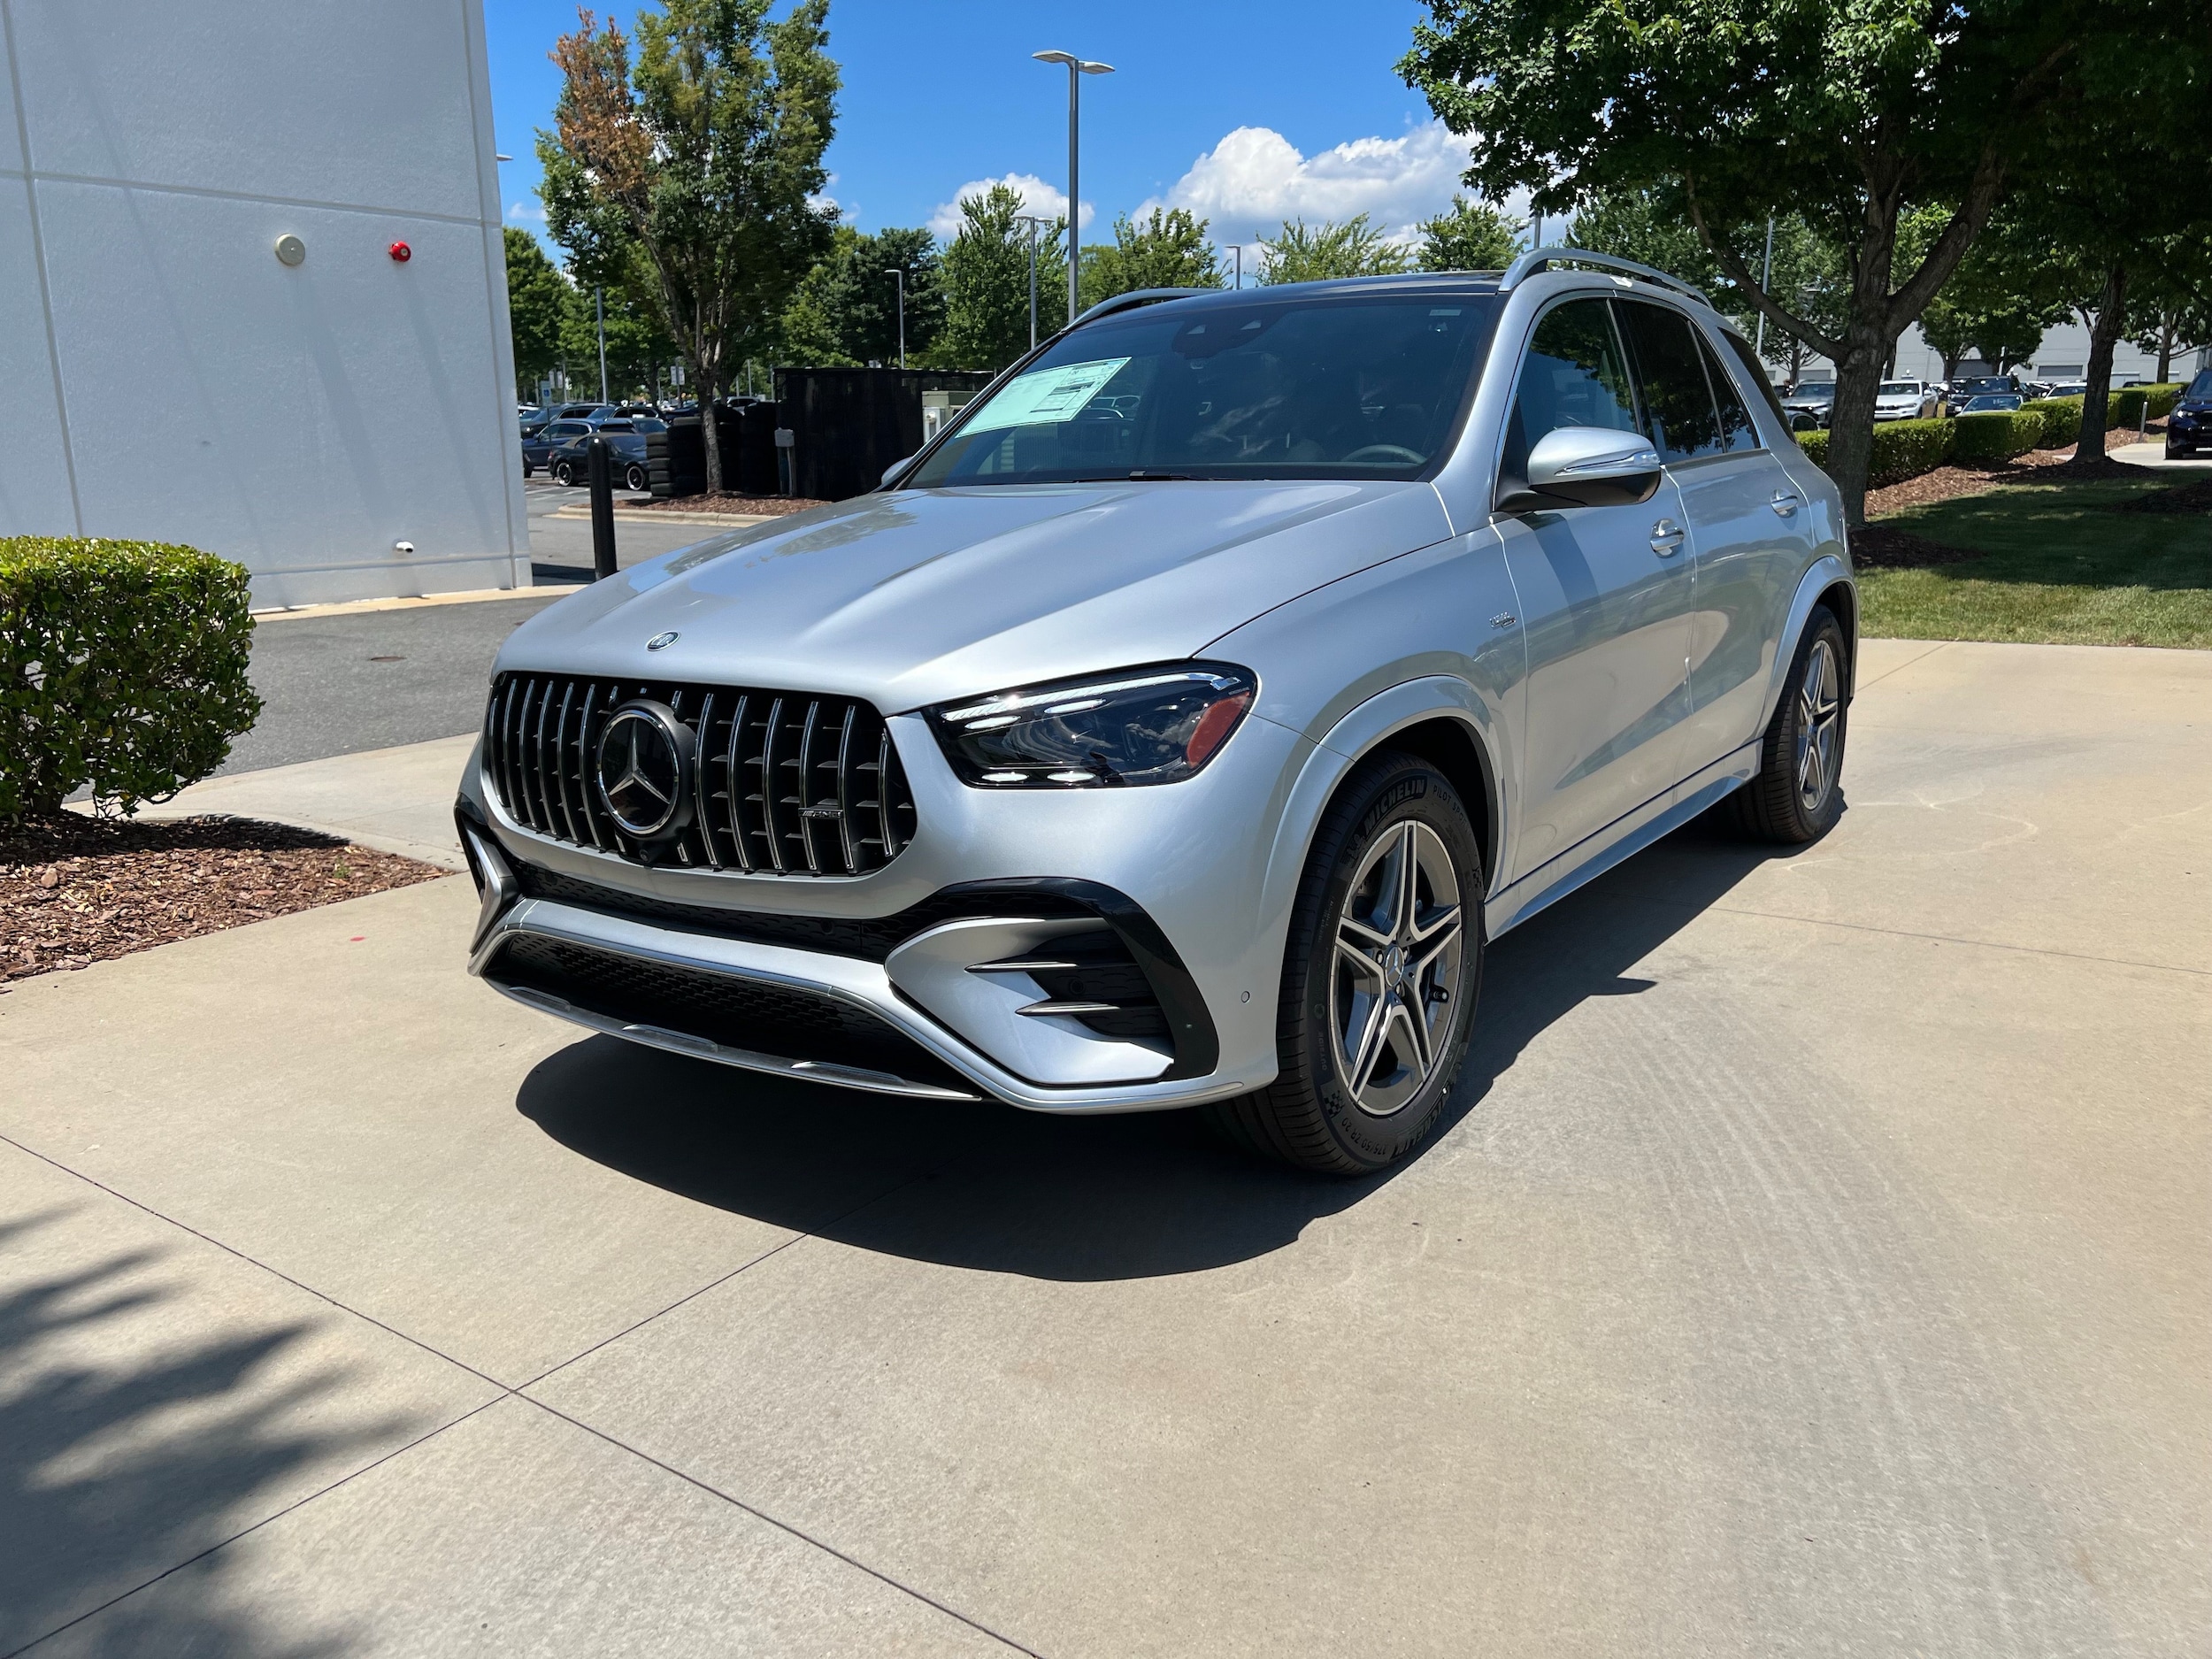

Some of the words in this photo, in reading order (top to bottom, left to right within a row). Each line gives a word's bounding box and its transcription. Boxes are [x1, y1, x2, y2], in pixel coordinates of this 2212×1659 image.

[1363, 779, 1425, 835] MICHELIN
[1432, 785, 1452, 804] PILOT
[1317, 1032, 1328, 1071] OUTSIDE
[1341, 1118, 1351, 1132] 20
